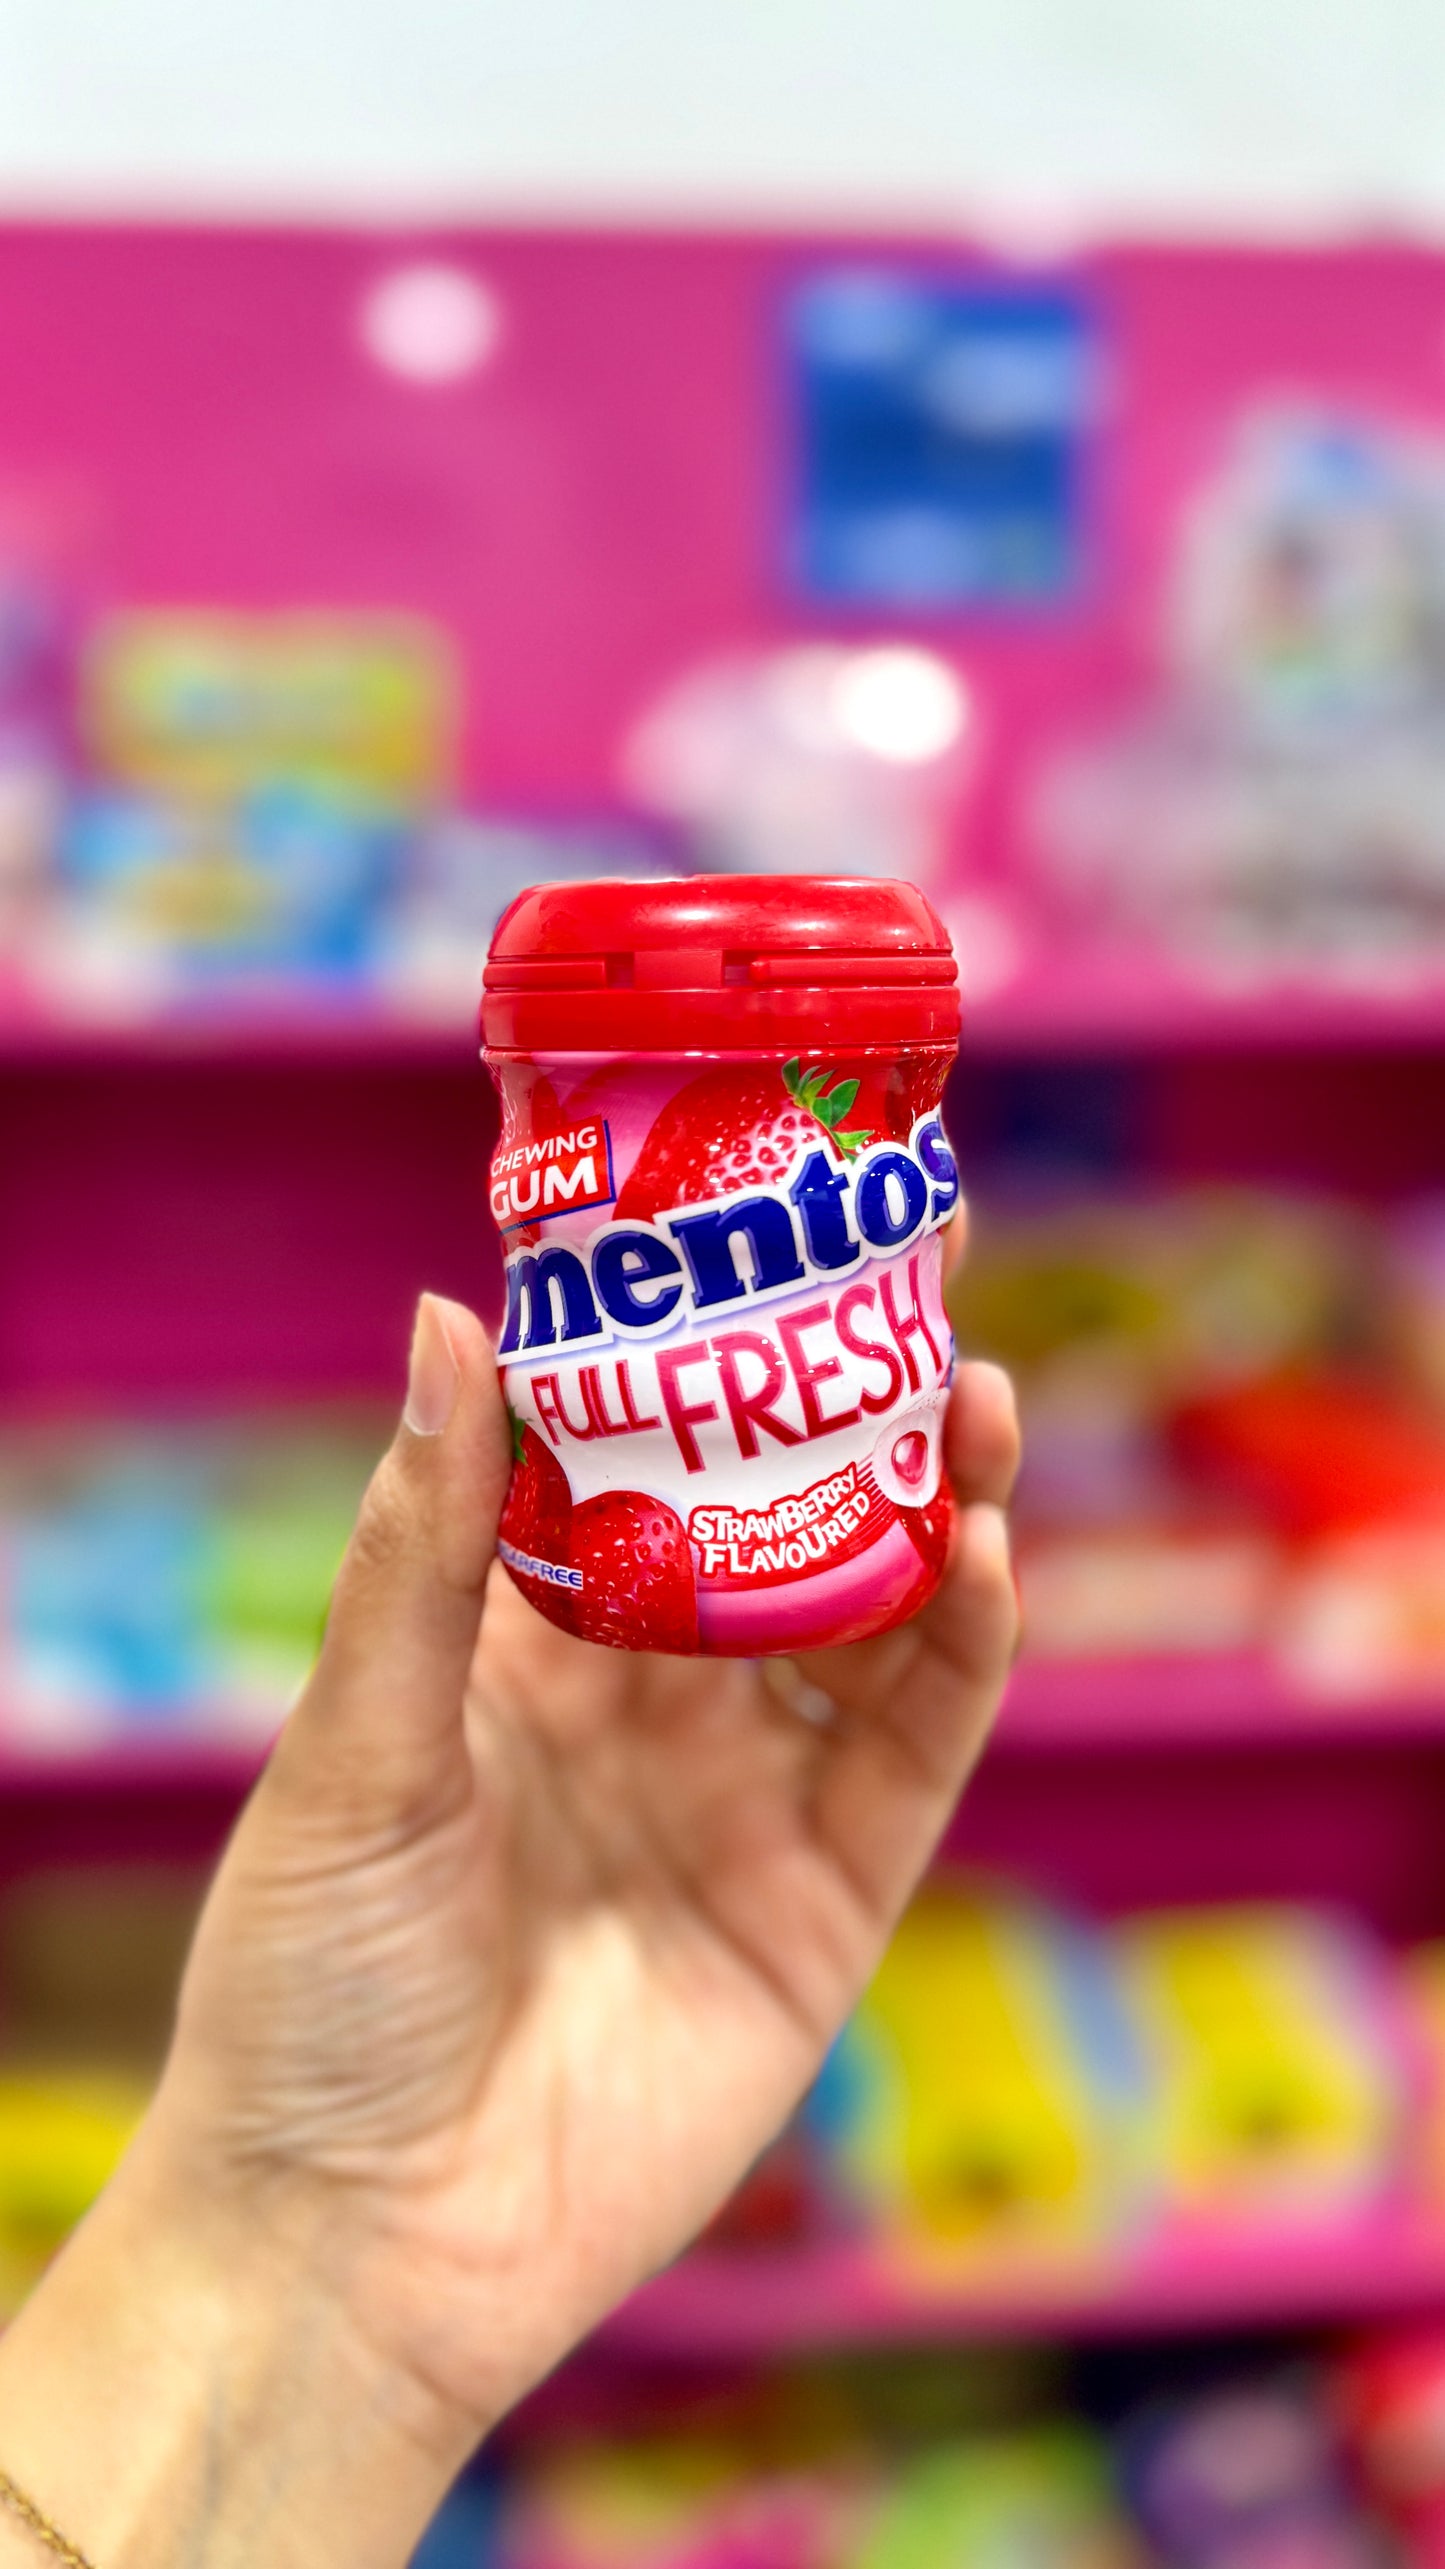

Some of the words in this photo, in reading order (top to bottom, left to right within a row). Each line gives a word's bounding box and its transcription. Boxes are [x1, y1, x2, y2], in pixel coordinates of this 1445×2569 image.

[490, 1156, 599, 1221] GUM
[491, 1126, 598, 1178] CHEWING
[499, 1119, 959, 1355] mentos
[530, 1359, 663, 1447] FULL
[654, 1252, 943, 1476] FRESH
[692, 1467, 857, 1542] STRAWBERRY
[703, 1491, 870, 1575] FLAVOURED
